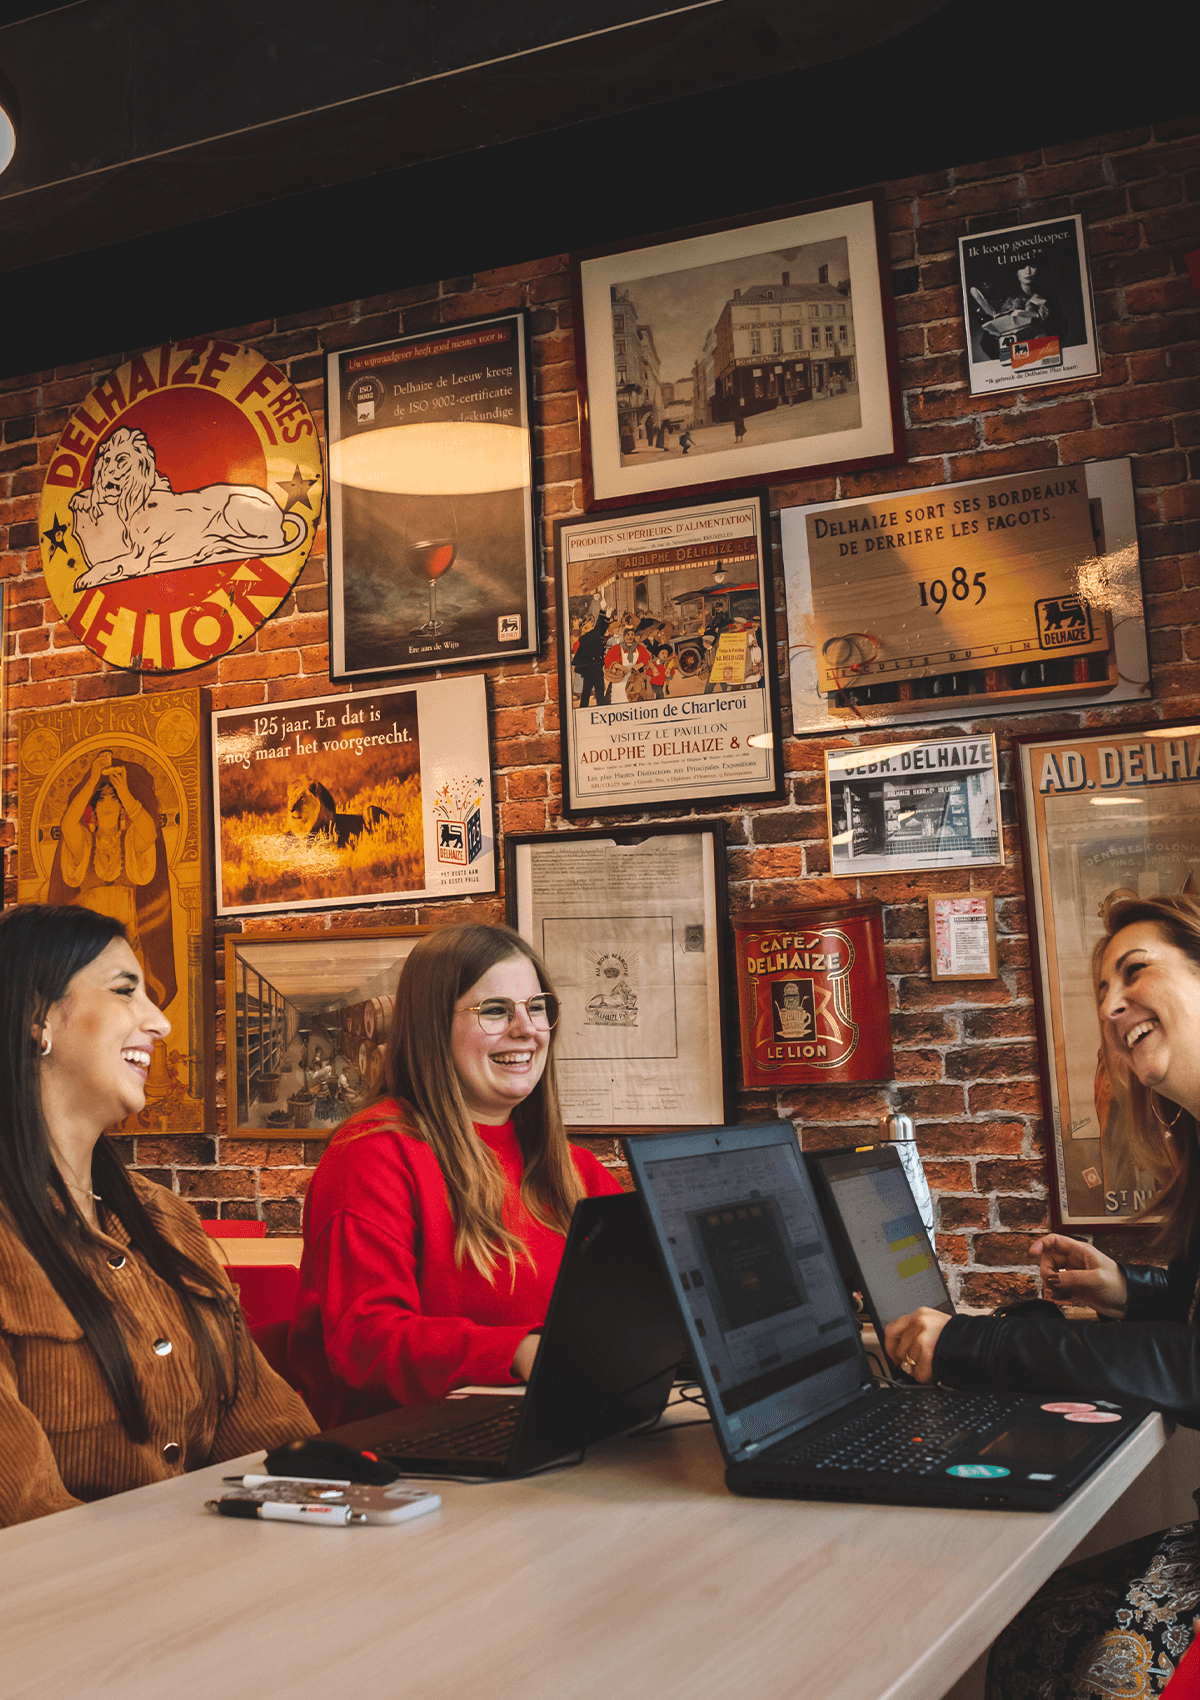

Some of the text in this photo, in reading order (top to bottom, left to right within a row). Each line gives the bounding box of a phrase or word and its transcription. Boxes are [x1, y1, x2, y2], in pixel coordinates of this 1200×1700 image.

[969, 248, 979, 256] Ik
[983, 243, 1010, 255] koop
[998, 256, 1007, 264] U
[478, 334, 496, 344] voor
[360, 385, 372, 394] ISO
[394, 366, 513, 396] Delhaize de Leeuw kreeg
[46, 339, 240, 488] DELHAIZE
[394, 405, 405, 417] de
[409, 400, 428, 413] ISO
[814, 480, 1079, 540] DELHAIZE SORT SES BORDEAUX
[570, 514, 752, 549] PRODUITS SUPÉRIEURS D'ALIMENTATION
[838, 506, 1056, 556] DE DERRIERE LES FAGOTS.
[624, 552, 671, 568] ADOLPHE
[676, 542, 734, 562] DELHAIZE
[918, 567, 987, 615] 1985
[408, 646, 420, 654] Ere
[434, 642, 442, 650] de
[444, 641, 460, 650] Wijn
[1044, 626, 1086, 646] DELHAIZE
[864, 656, 930, 673] CULTE
[950, 650, 972, 661] DU
[993, 642, 1030, 654] VIN
[253, 704, 381, 741] 125 jaar. En dat is
[590, 696, 746, 726] Exposition de Charleroi
[225, 721, 413, 770] nog maar het voorgerecht.
[610, 723, 728, 744] VISITEZ LE PAVILLON
[580, 744, 646, 764] ADOLPHE
[652, 738, 724, 757] DELHAIZE
[730, 736, 740, 749] &
[902, 743, 993, 771] DELHAIZE
[686, 762, 720, 774] Principales
[722, 759, 757, 771] Expositions
[1039, 751, 1096, 794] AD.
[440, 848, 464, 861] DELHAIZE
[748, 952, 840, 974] DELHAIZE
[768, 1045, 828, 1059] LE LION
